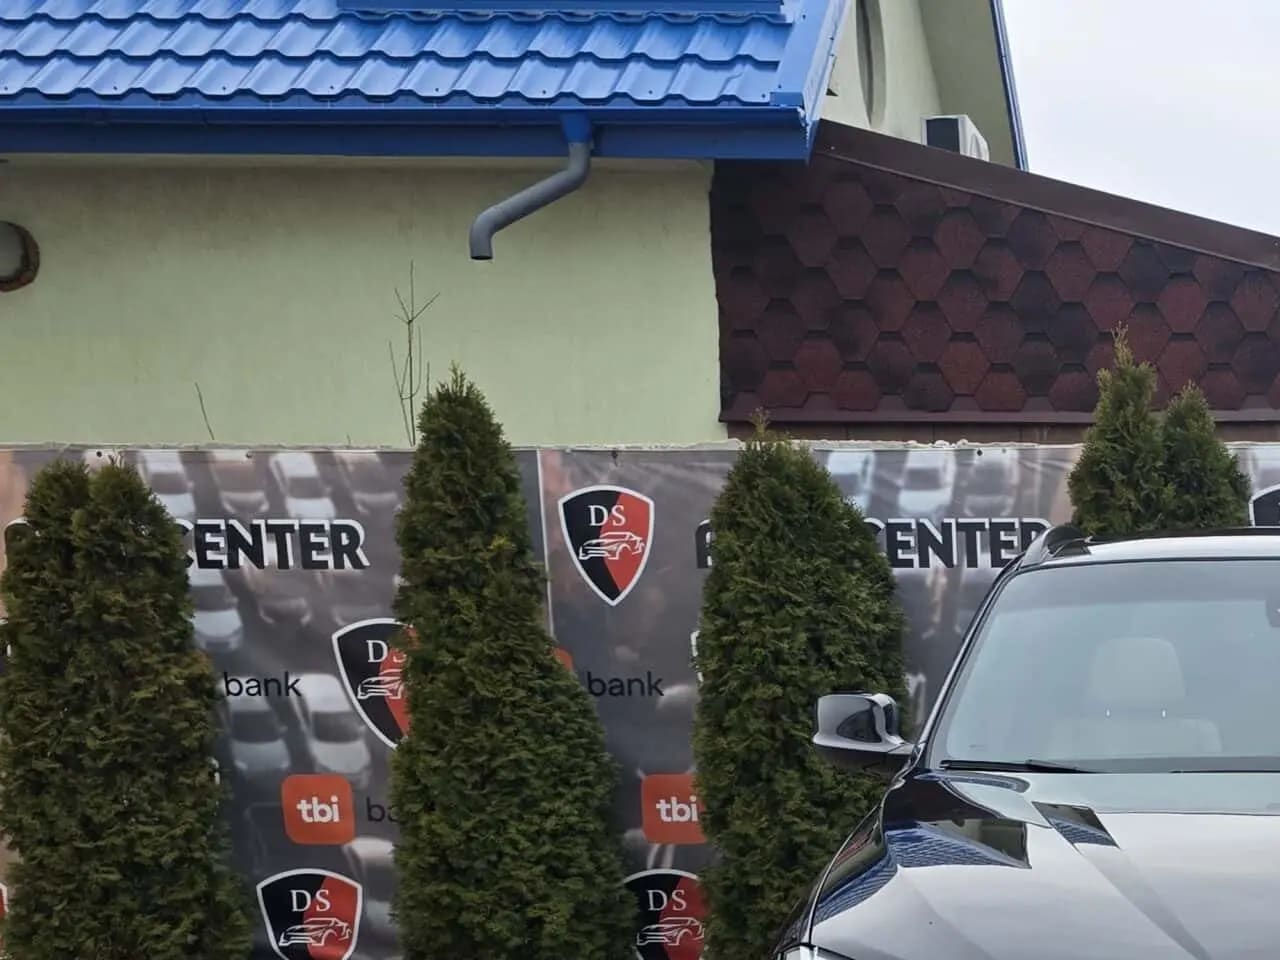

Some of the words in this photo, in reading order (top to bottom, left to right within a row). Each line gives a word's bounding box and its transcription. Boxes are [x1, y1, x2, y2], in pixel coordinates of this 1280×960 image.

[588, 504, 627, 526] DS
[224, 671, 305, 698] bank
[587, 671, 665, 697] bank
[296, 795, 340, 823] tbi
[655, 796, 699, 822] tbi
[290, 889, 331, 912] DS
[647, 890, 687, 911] DS
